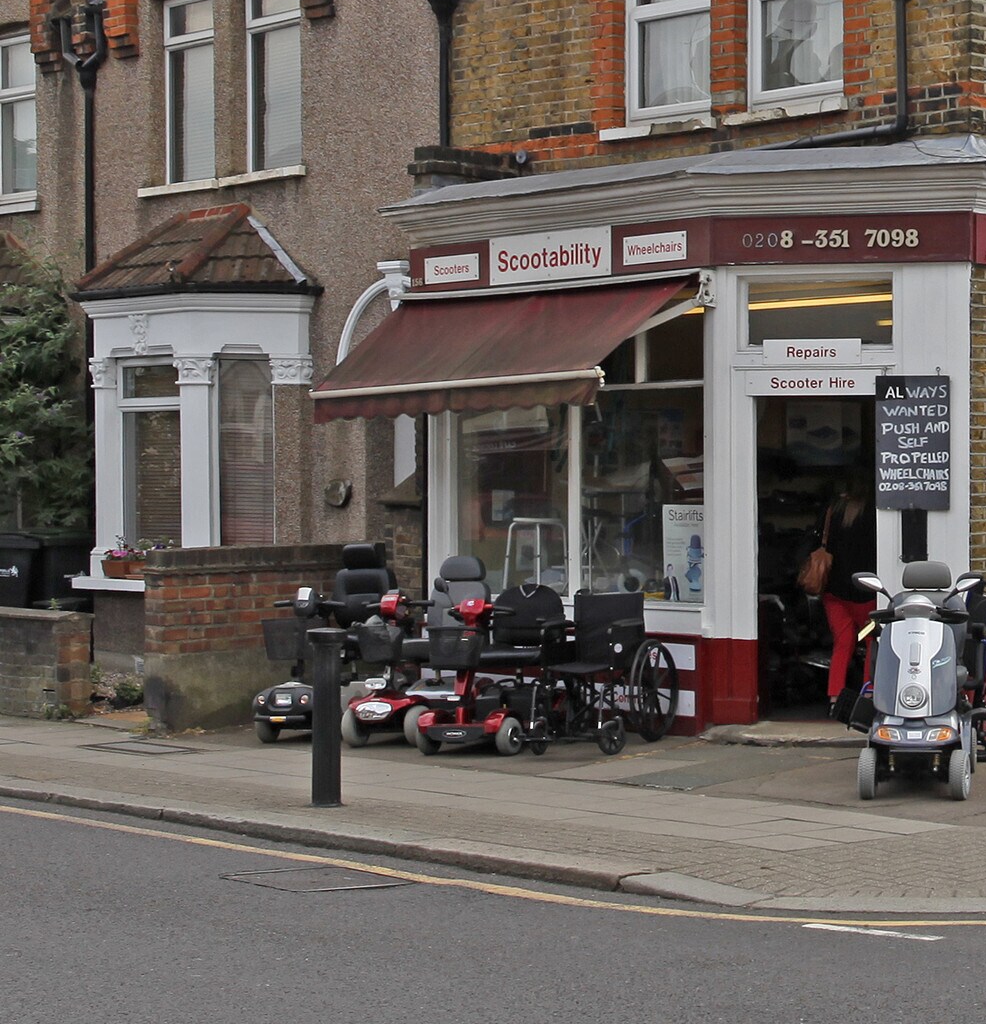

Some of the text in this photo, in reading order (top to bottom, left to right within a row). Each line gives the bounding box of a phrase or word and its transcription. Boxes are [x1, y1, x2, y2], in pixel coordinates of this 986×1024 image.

[742, 230, 793, 248] 0208
[865, 228, 919, 247] 7098
[627, 241, 683, 256] Wheelchairs
[498, 242, 602, 272] Scootability
[434, 263, 470, 276] Scooters
[787, 346, 836, 359] Repairs
[771, 377, 855, 388] Scooter Hire
[885, 385, 947, 399] ALWAYS
[883, 405, 948, 417] WANTED
[881, 421, 949, 435] PUSH AND
[898, 436, 928, 448] SELF
[881, 452, 949, 464] PROPELLED
[880, 468, 949, 480] WHEELCHAIRS
[668, 509, 704, 521] Stairlifts
